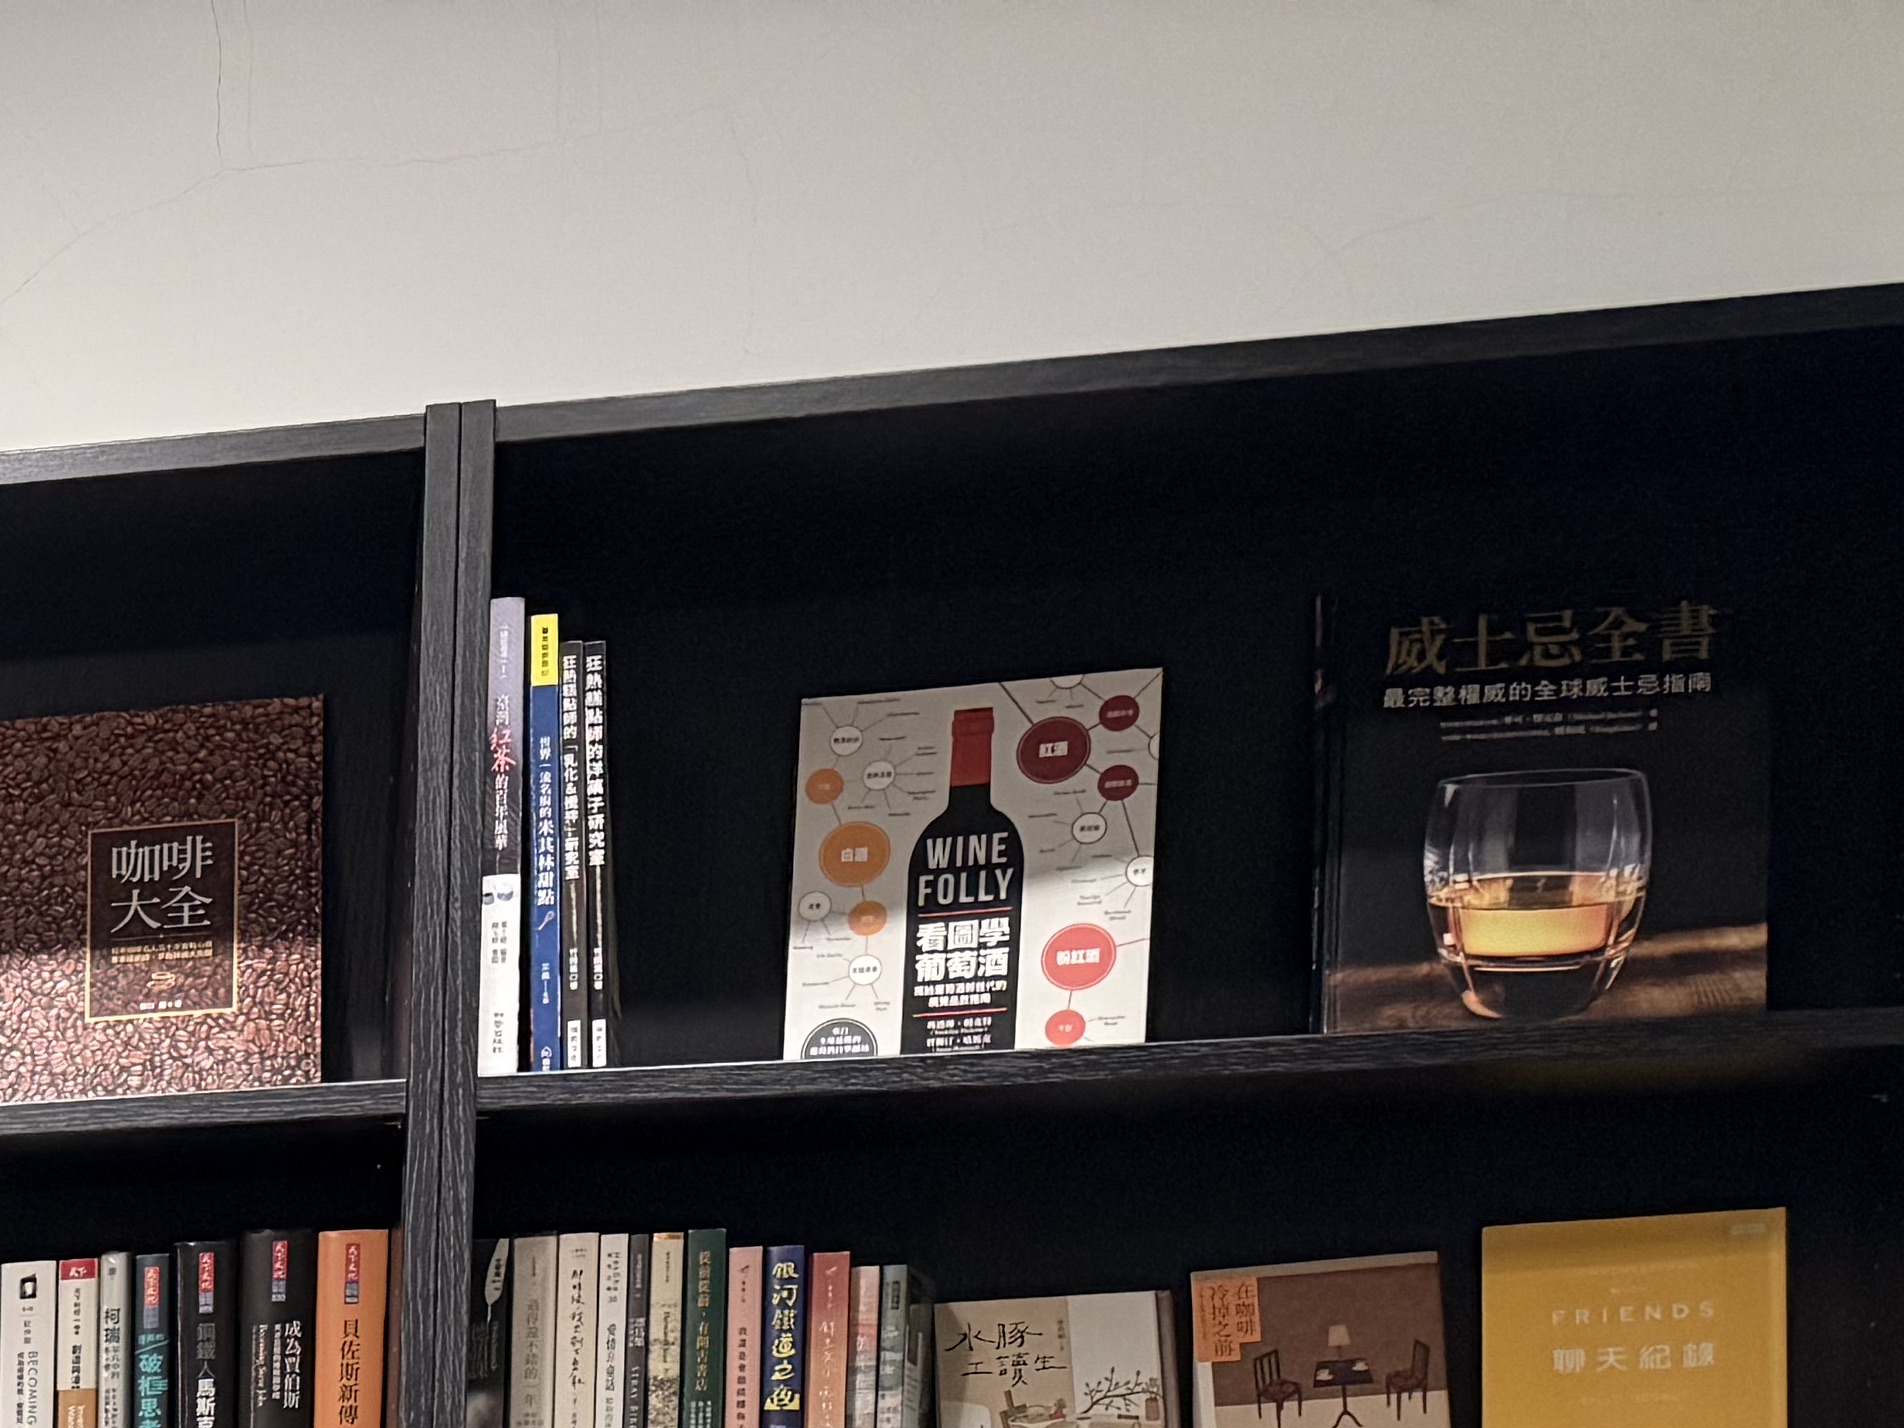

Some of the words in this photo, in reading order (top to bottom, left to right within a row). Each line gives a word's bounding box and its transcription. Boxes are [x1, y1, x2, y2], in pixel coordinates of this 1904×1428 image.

[1386, 600, 1720, 676] 威士忌全書
[1383, 672, 1712, 709] 最完整權威的全球威士忌指南
[110, 835, 214, 883] 咖啡
[926, 832, 1009, 869] WINE
[918, 868, 1014, 907] FOLLY
[110, 885, 213, 934] 大全
[916, 917, 1010, 951] 看圖學
[915, 949, 1009, 982] 葡萄酒
[1209, 1284, 1236, 1361] 冷掉之前
[1235, 1282, 1258, 1338] 在咖啡
[1552, 1301, 1715, 1327] FRIENDS
[764, 1262, 800, 1410] 銀河鐵道之夜
[945, 1320, 1043, 1352] 水豚
[336, 1319, 362, 1425] 貝佐斯新傳
[960, 1353, 1068, 1387] 工讀生
[1553, 1342, 1715, 1374] 聊天紀錄
[26, 1350, 40, 1424] BECOMING
